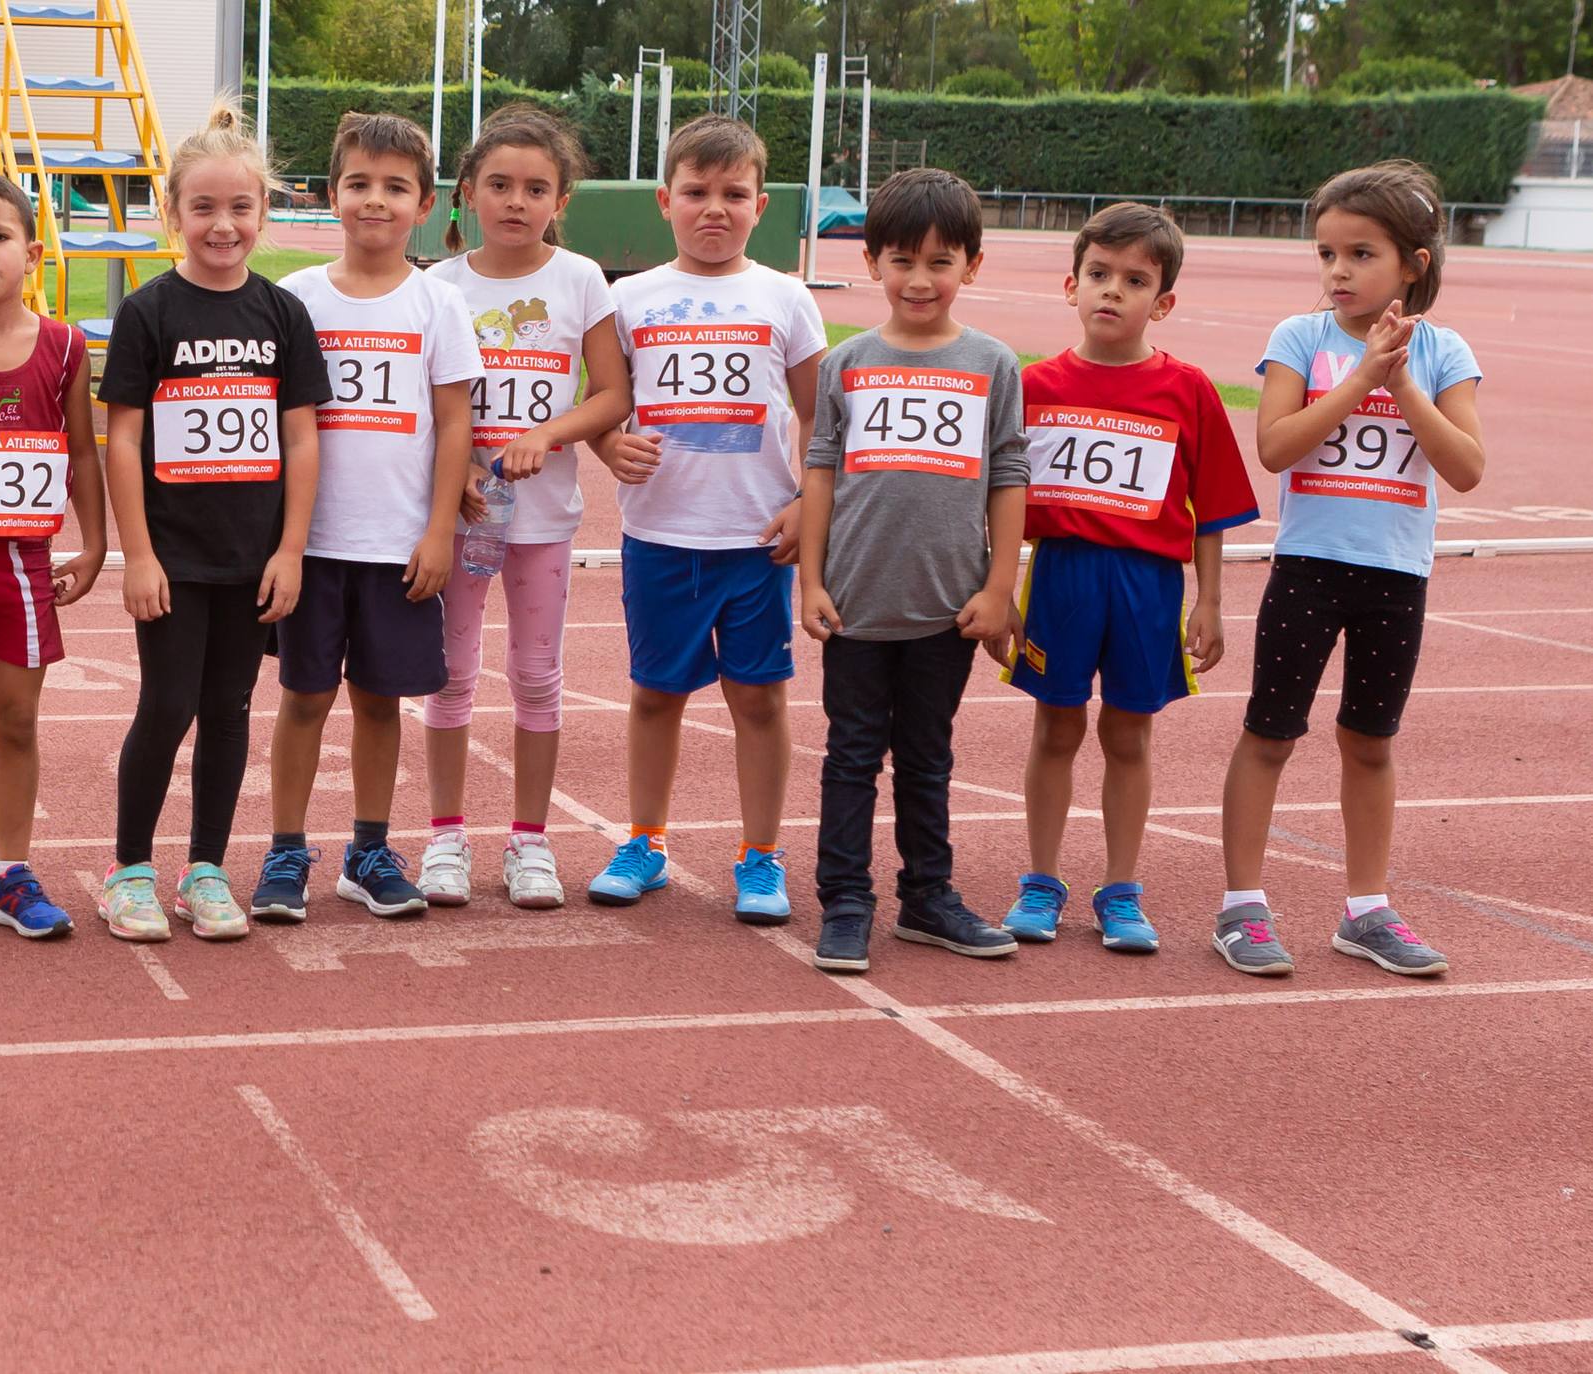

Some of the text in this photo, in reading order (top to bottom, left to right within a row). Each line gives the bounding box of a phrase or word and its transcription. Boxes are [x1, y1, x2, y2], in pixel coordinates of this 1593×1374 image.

[318, 337, 407, 350] OJA ATLETISMO
[643, 331, 759, 344] LA RIOJA ATLETISMO
[173, 339, 277, 366] ADIDAS
[503, 356, 562, 370] ATLETISMO
[335, 358, 397, 405] 31
[657, 352, 751, 397] 438
[854, 374, 974, 391] LA RIOJA ATLETISMO
[167, 385, 272, 398] LA RIOJA ATLETISMO
[471, 376, 553, 423] 418
[184, 407, 270, 454] 398
[863, 396, 963, 447] 458
[1040, 413, 1163, 437] LA RIOJA ATLETISMO
[5, 437, 59, 450] ATLETISMO
[1318, 423, 1418, 475] 397
[1049, 436, 1145, 493] 461
[1301, 477, 1419, 498] www.lariojaatletismo.com
[1033, 489, 1149, 512] www.lariojaatletismo.com
